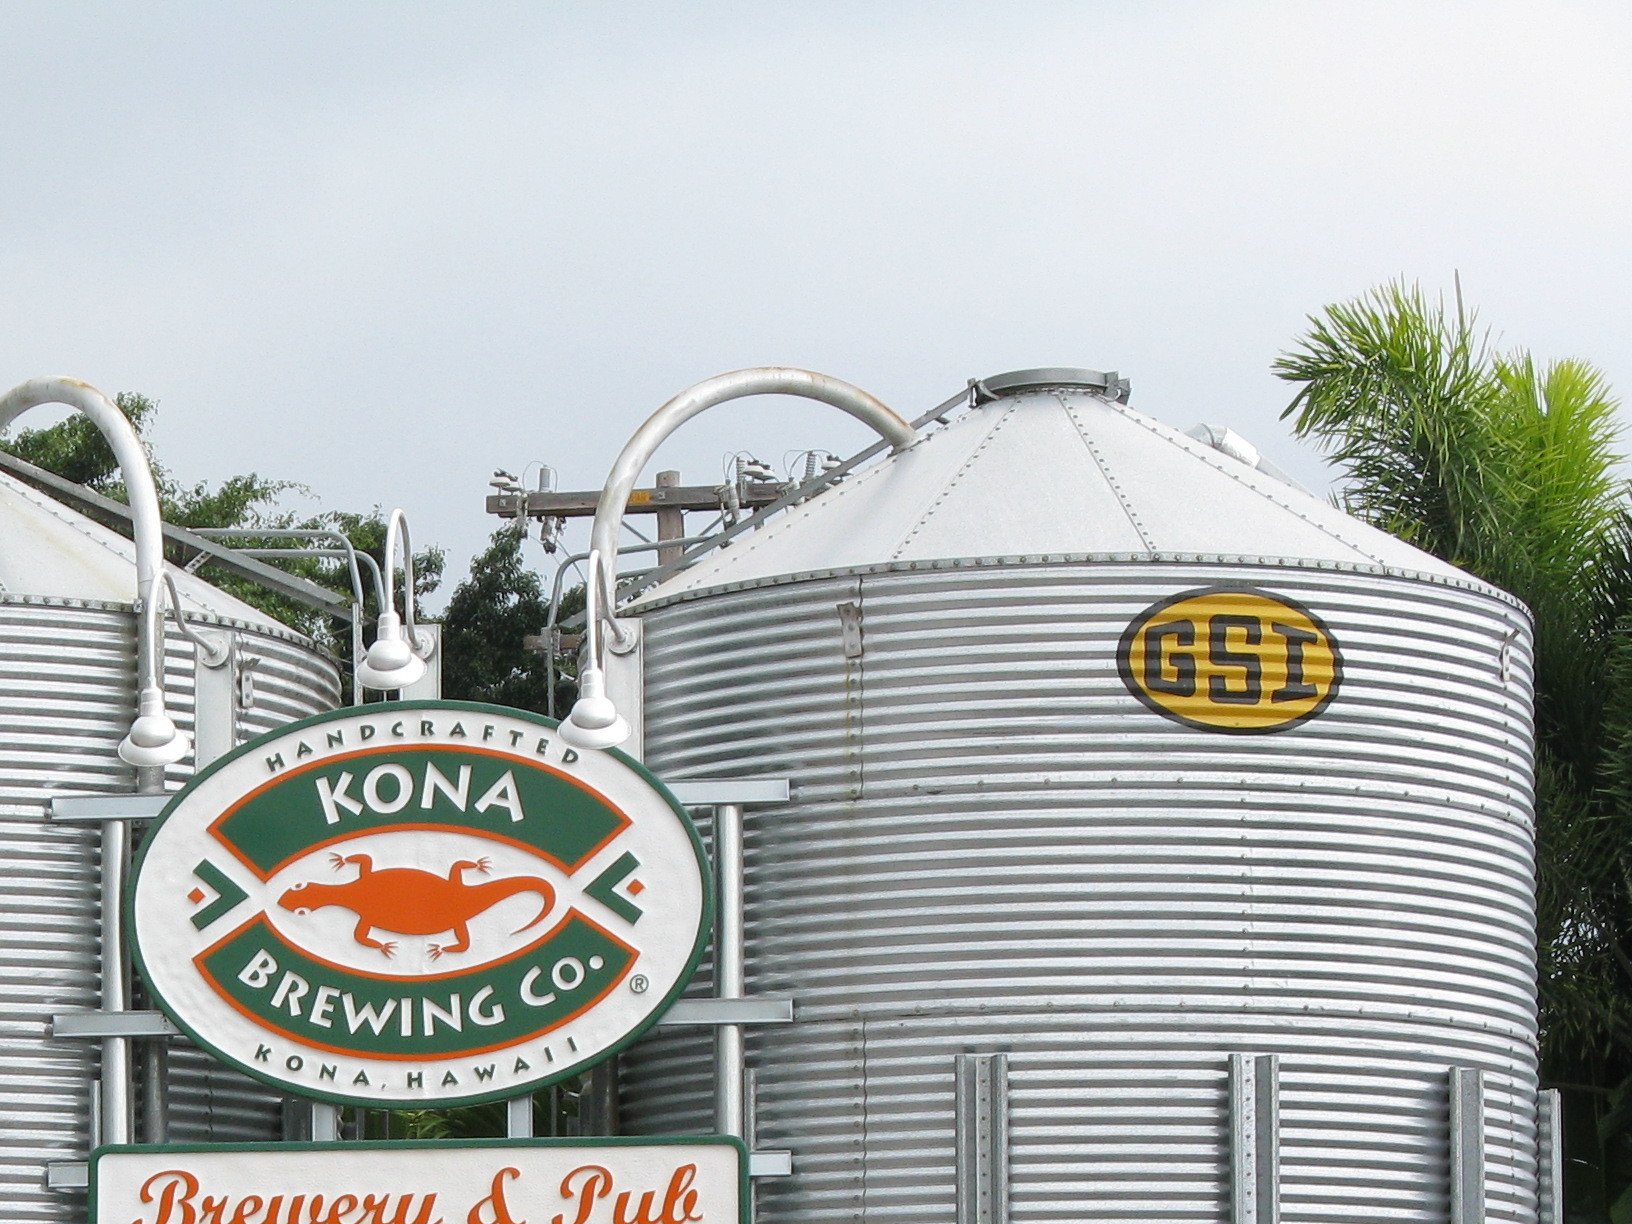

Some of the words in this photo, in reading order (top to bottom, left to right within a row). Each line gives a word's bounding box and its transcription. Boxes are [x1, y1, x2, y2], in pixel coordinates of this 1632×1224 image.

[1144, 614, 1318, 705] GSI
[265, 720, 579, 772] HANDCRAFTED
[314, 761, 525, 825] KONA
[236, 948, 506, 1038] BREWING
[519, 954, 605, 1007] CO.
[253, 1043, 388, 1090] KONA,
[406, 1036, 578, 1089] HAWAII
